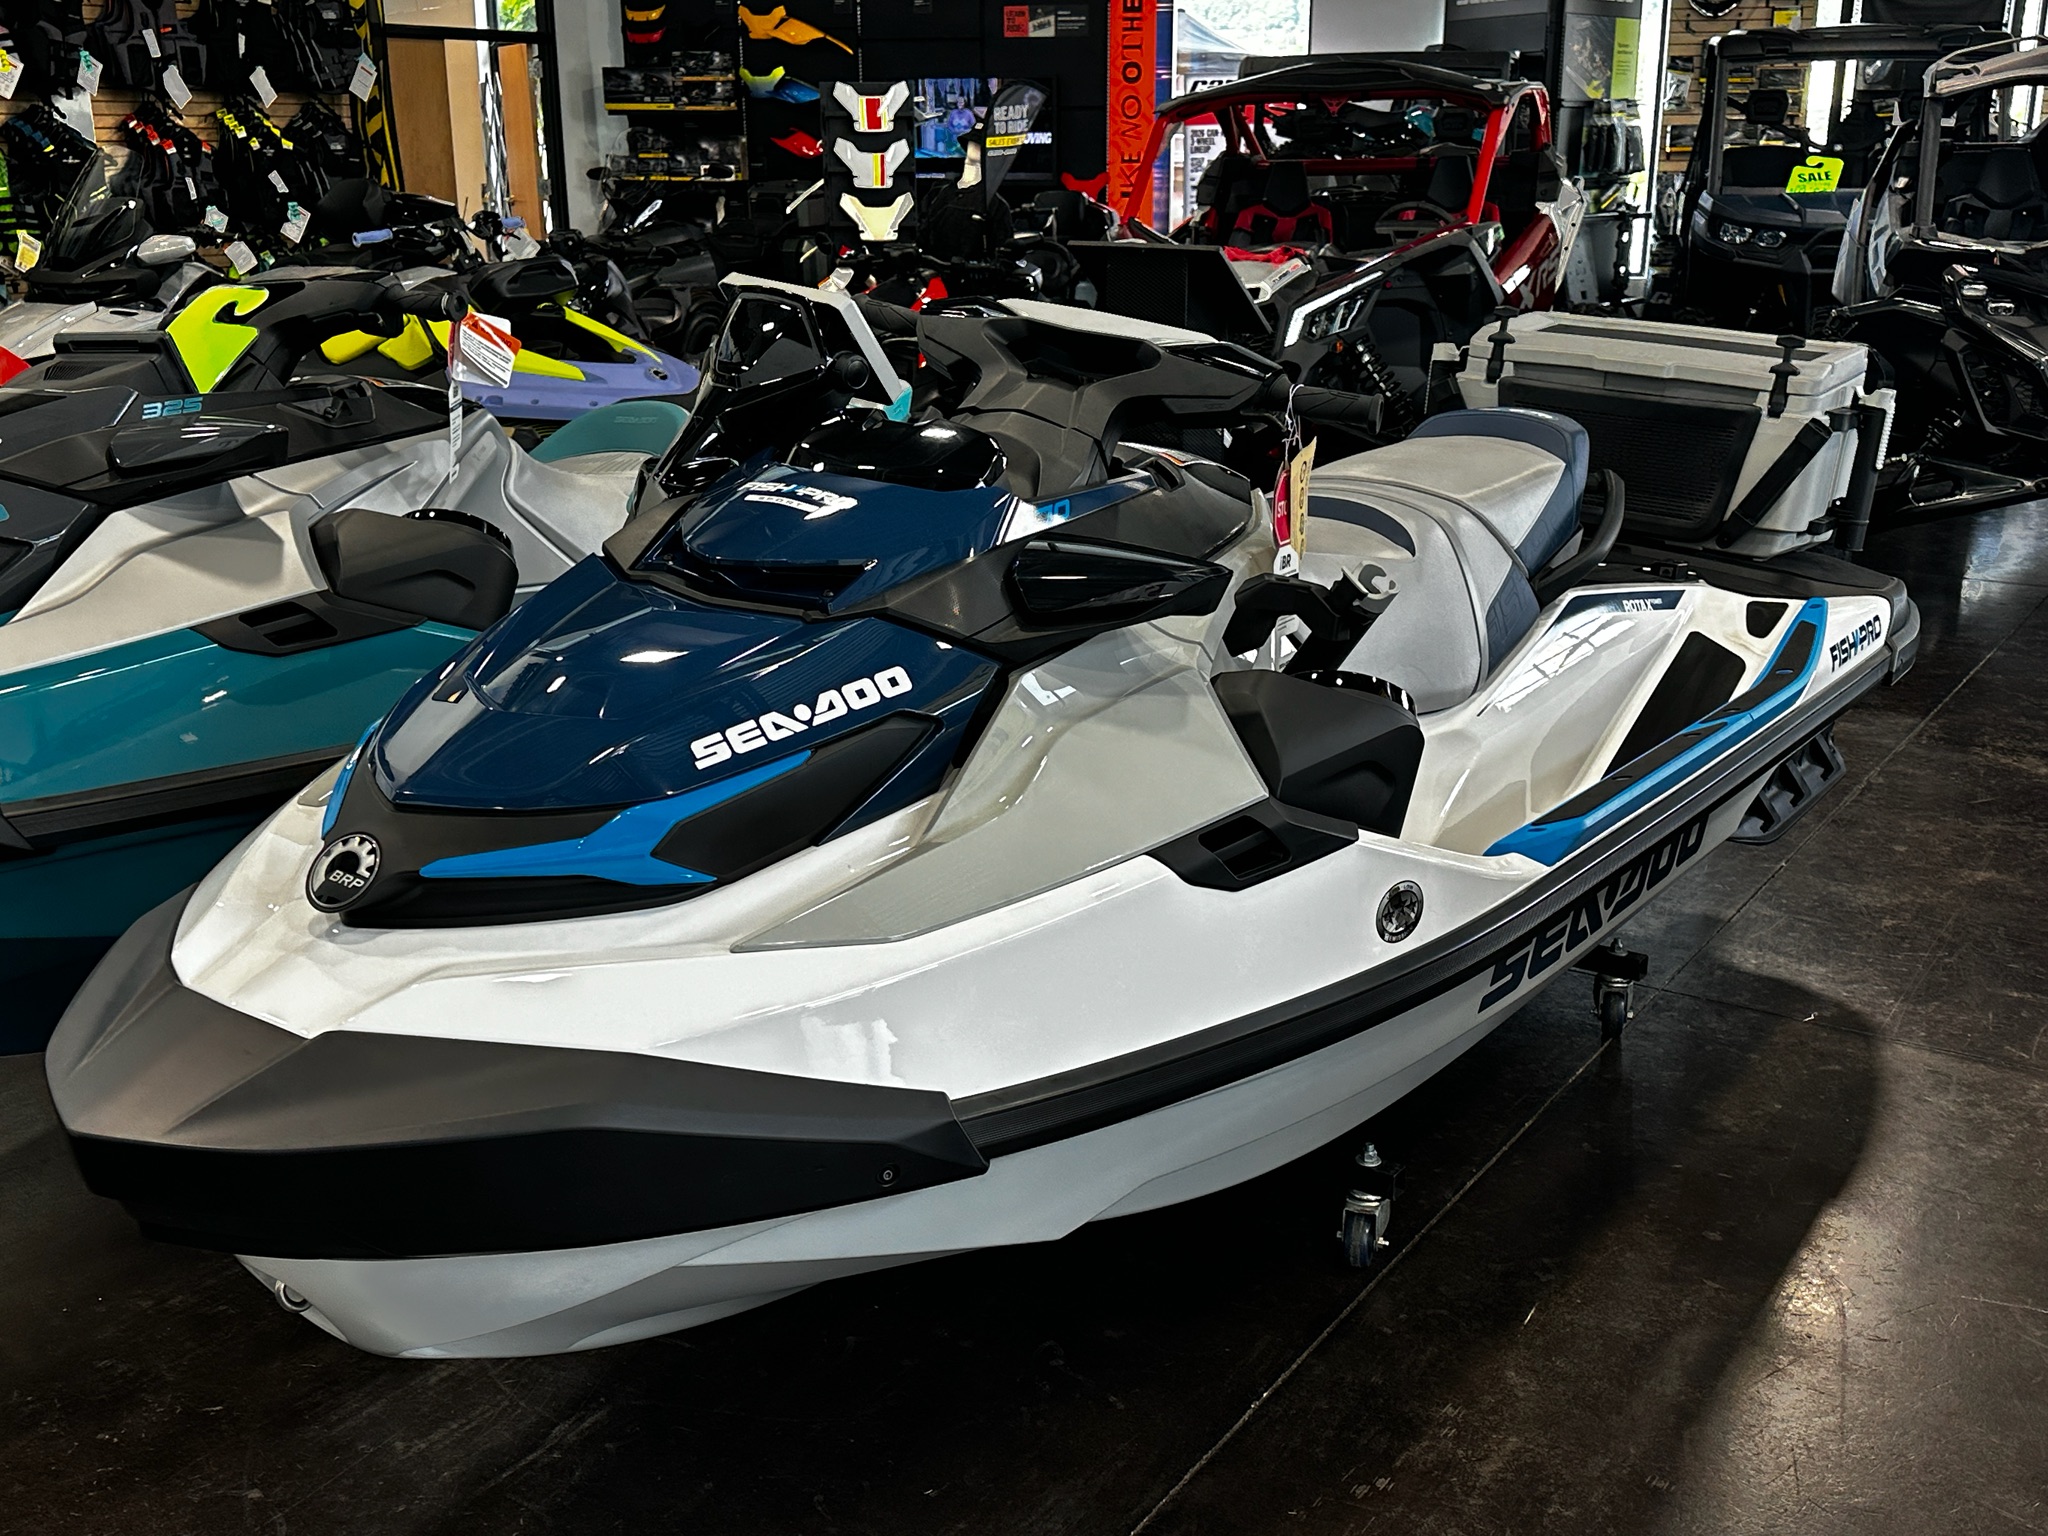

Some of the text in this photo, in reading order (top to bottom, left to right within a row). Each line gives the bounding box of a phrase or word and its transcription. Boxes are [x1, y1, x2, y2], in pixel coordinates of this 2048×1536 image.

[993, 104, 1029, 120] READY
[1120, 95, 1143, 141] NO
[993, 119, 1029, 134] TO RIDE
[1797, 170, 1832, 183] SALE
[141, 396, 203, 420] 325
[758, 496, 804, 507] SPORT
[328, 869, 365, 889] BRP
